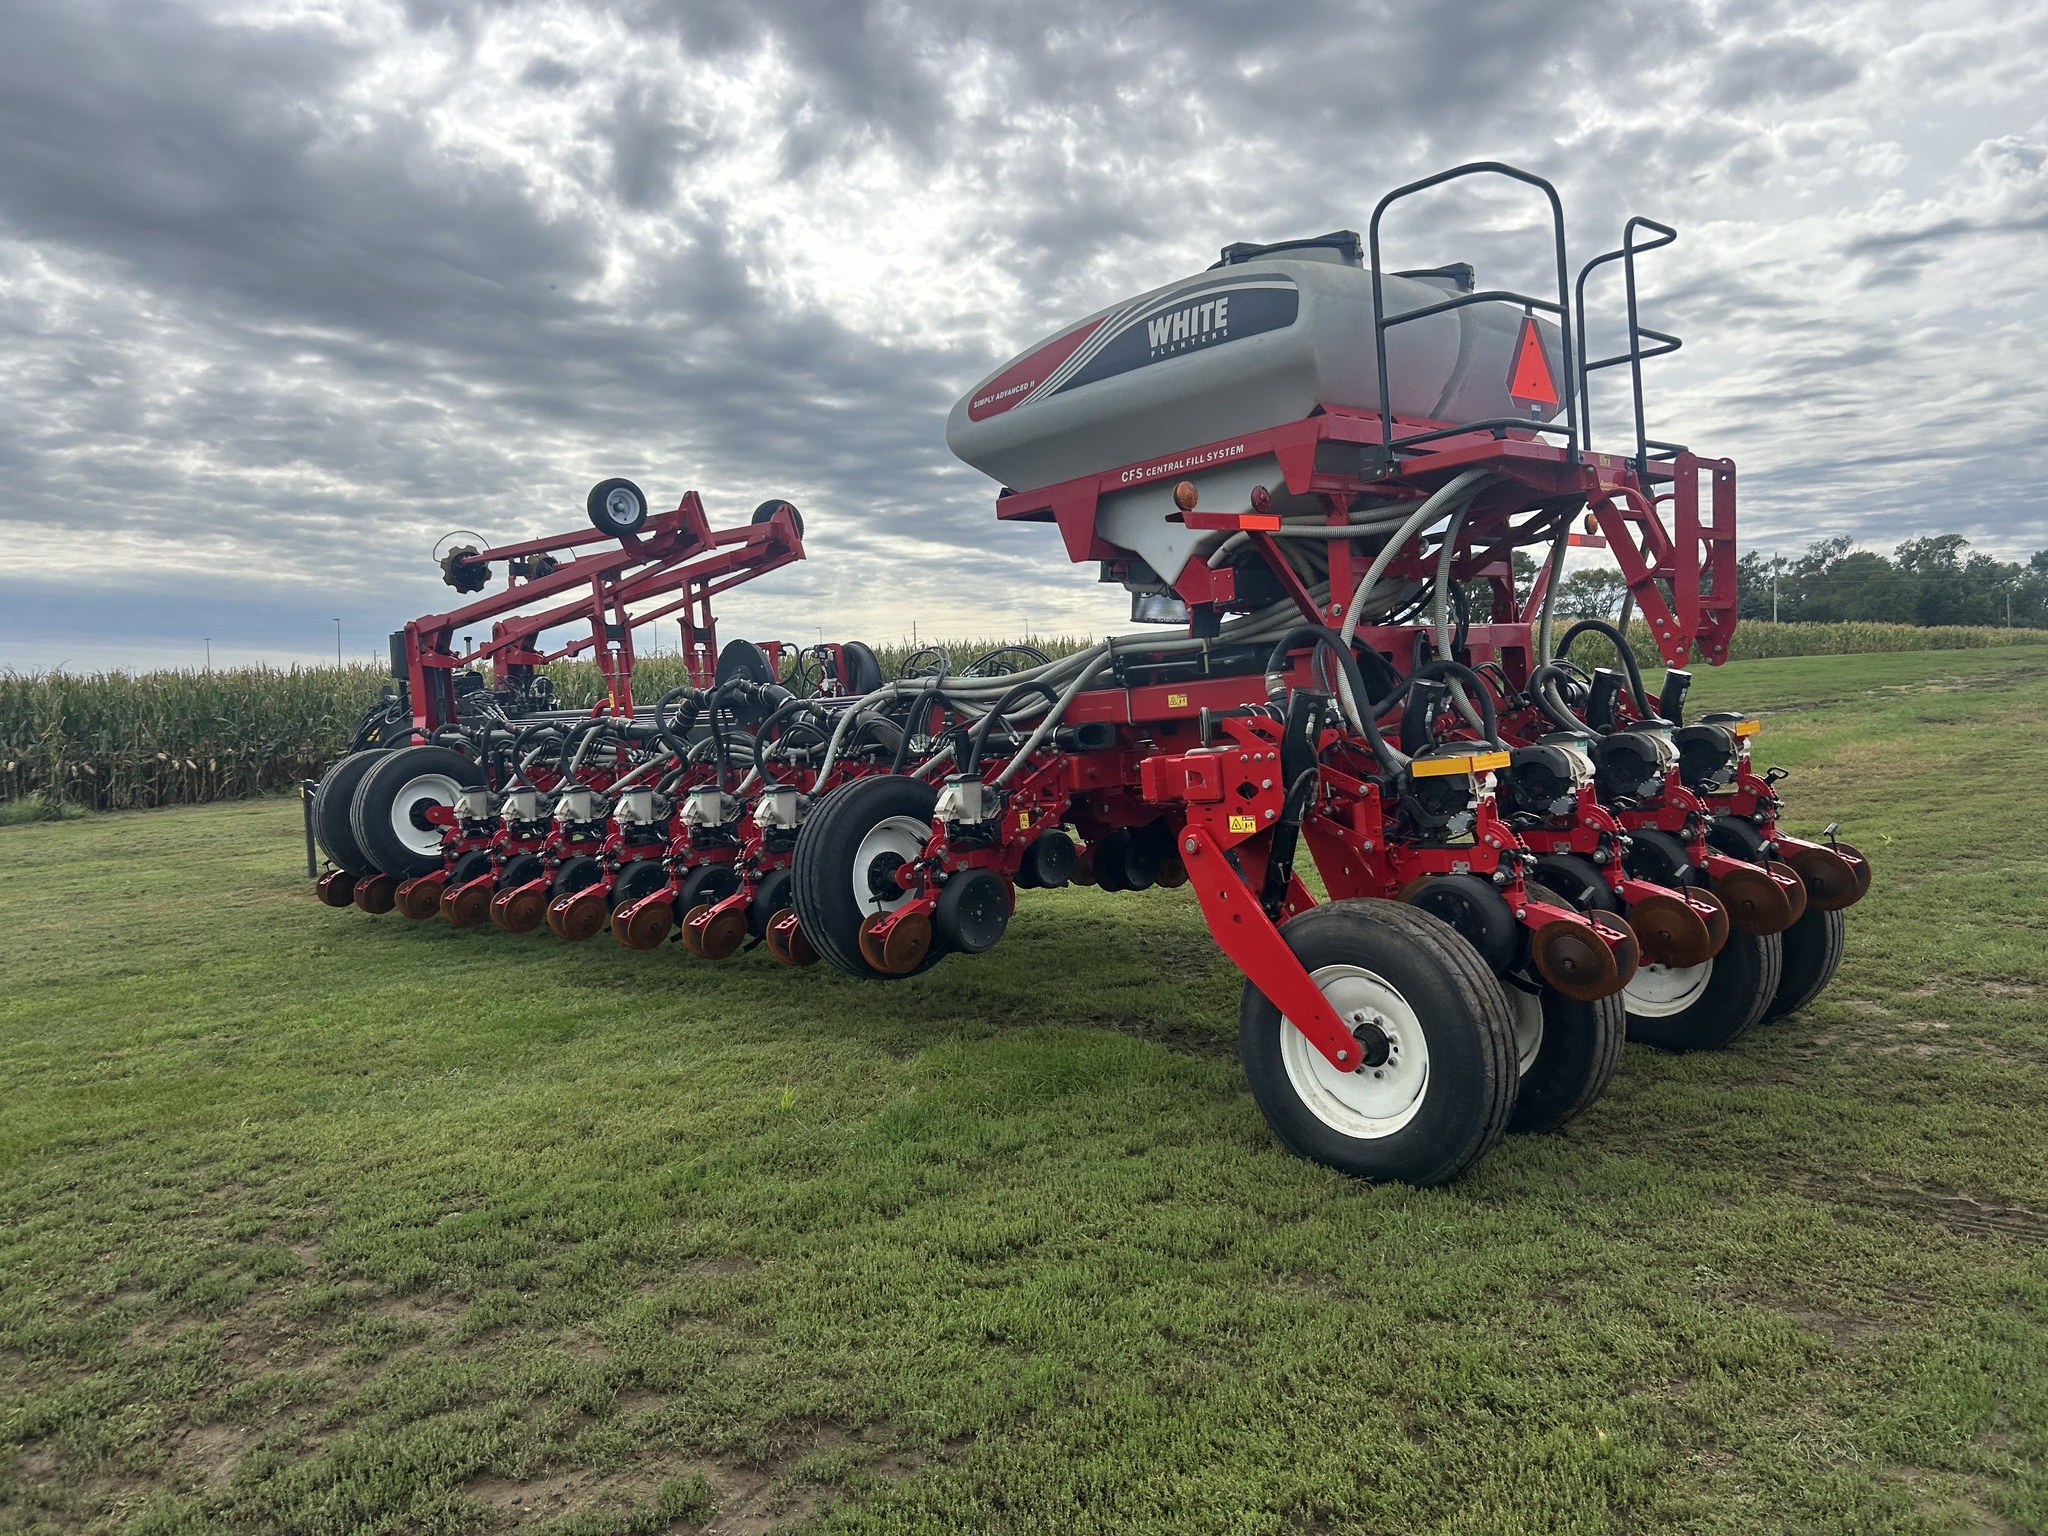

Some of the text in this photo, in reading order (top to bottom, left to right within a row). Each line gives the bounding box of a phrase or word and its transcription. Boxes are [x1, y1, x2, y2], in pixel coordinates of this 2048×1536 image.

[1147, 296, 1229, 348] WHITE
[1150, 329, 1228, 358] PLANTERS
[973, 394, 995, 409] SIMPLY
[995, 382, 1029, 401] ADVANCED
[1121, 444, 1244, 483] CFS CENTRAL FILL SYSTEM
